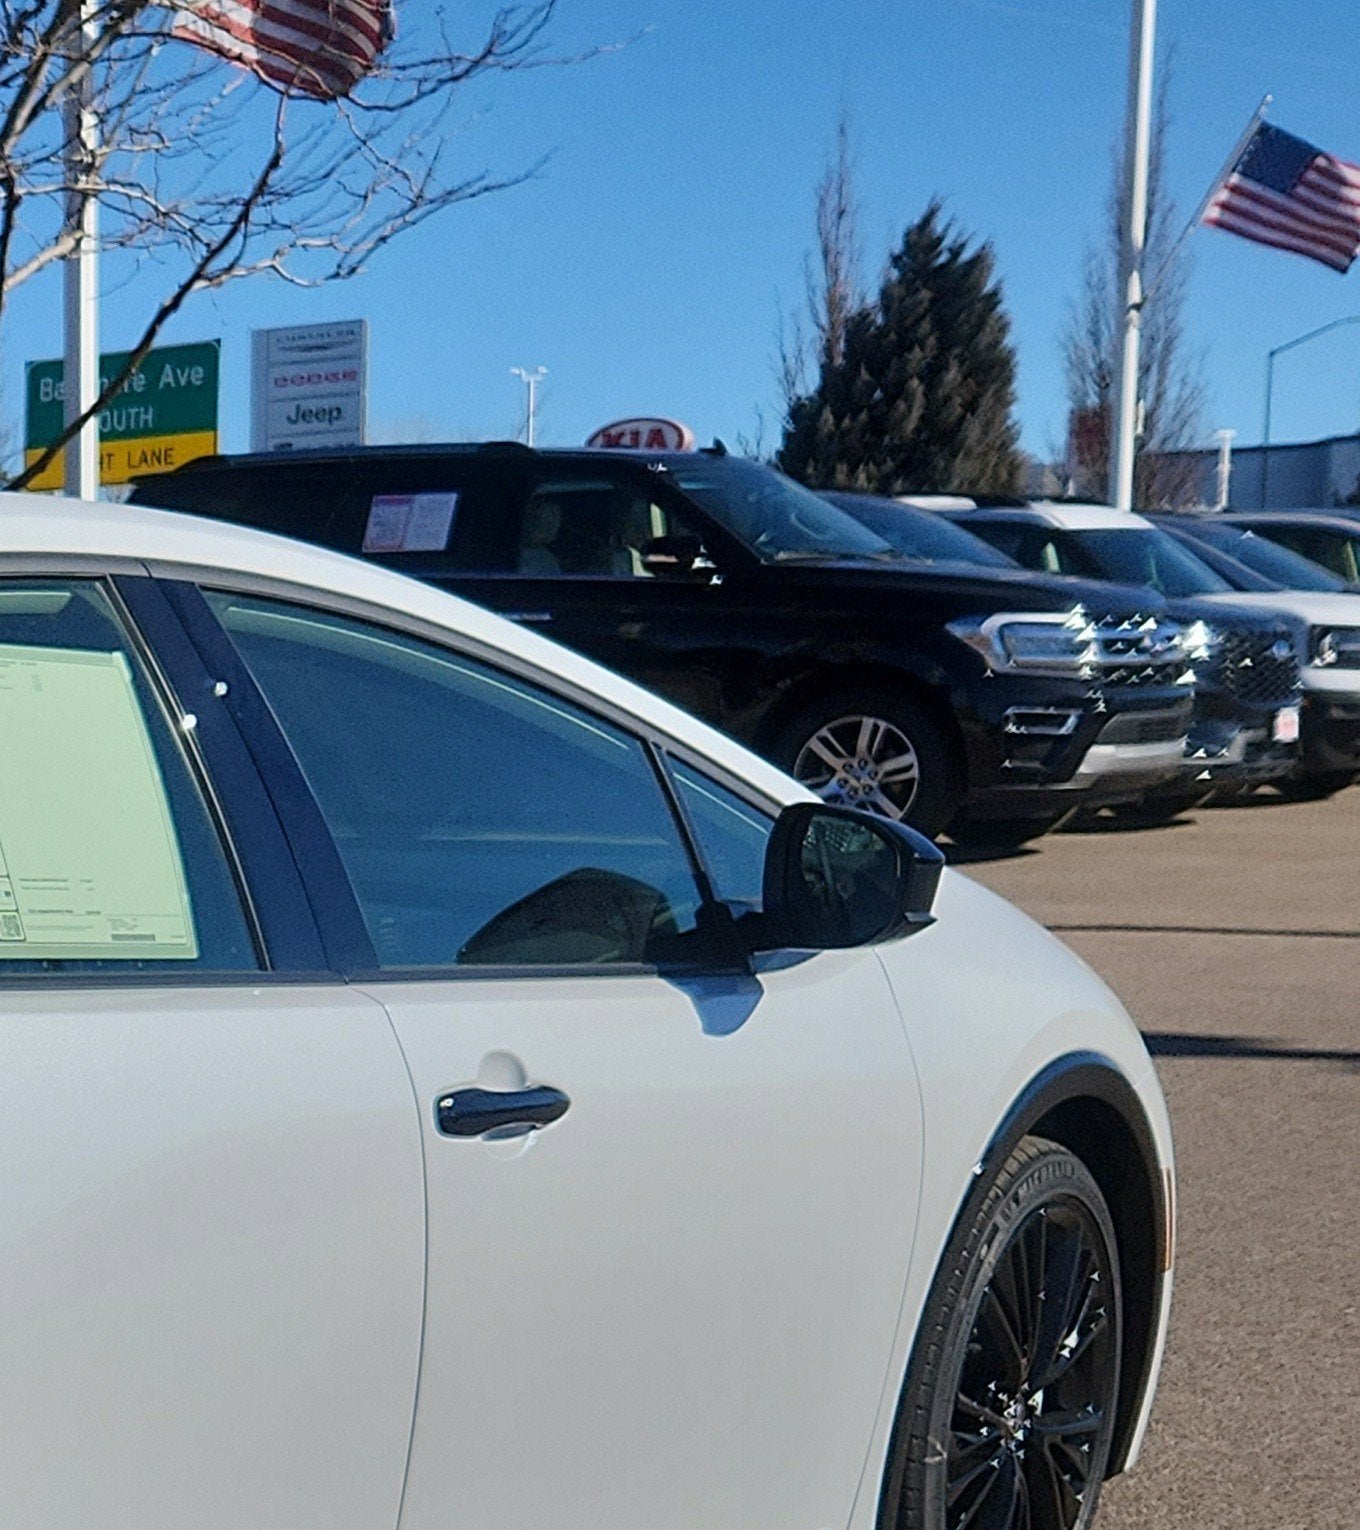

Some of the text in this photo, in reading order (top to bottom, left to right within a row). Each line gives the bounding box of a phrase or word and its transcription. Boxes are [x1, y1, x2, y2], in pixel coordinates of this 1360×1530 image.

[159, 363, 204, 390] Ave
[98, 405, 153, 432] OUTH
[285, 403, 342, 425] Jeep
[601, 428, 668, 449] KIA
[128, 448, 175, 469] LANE
